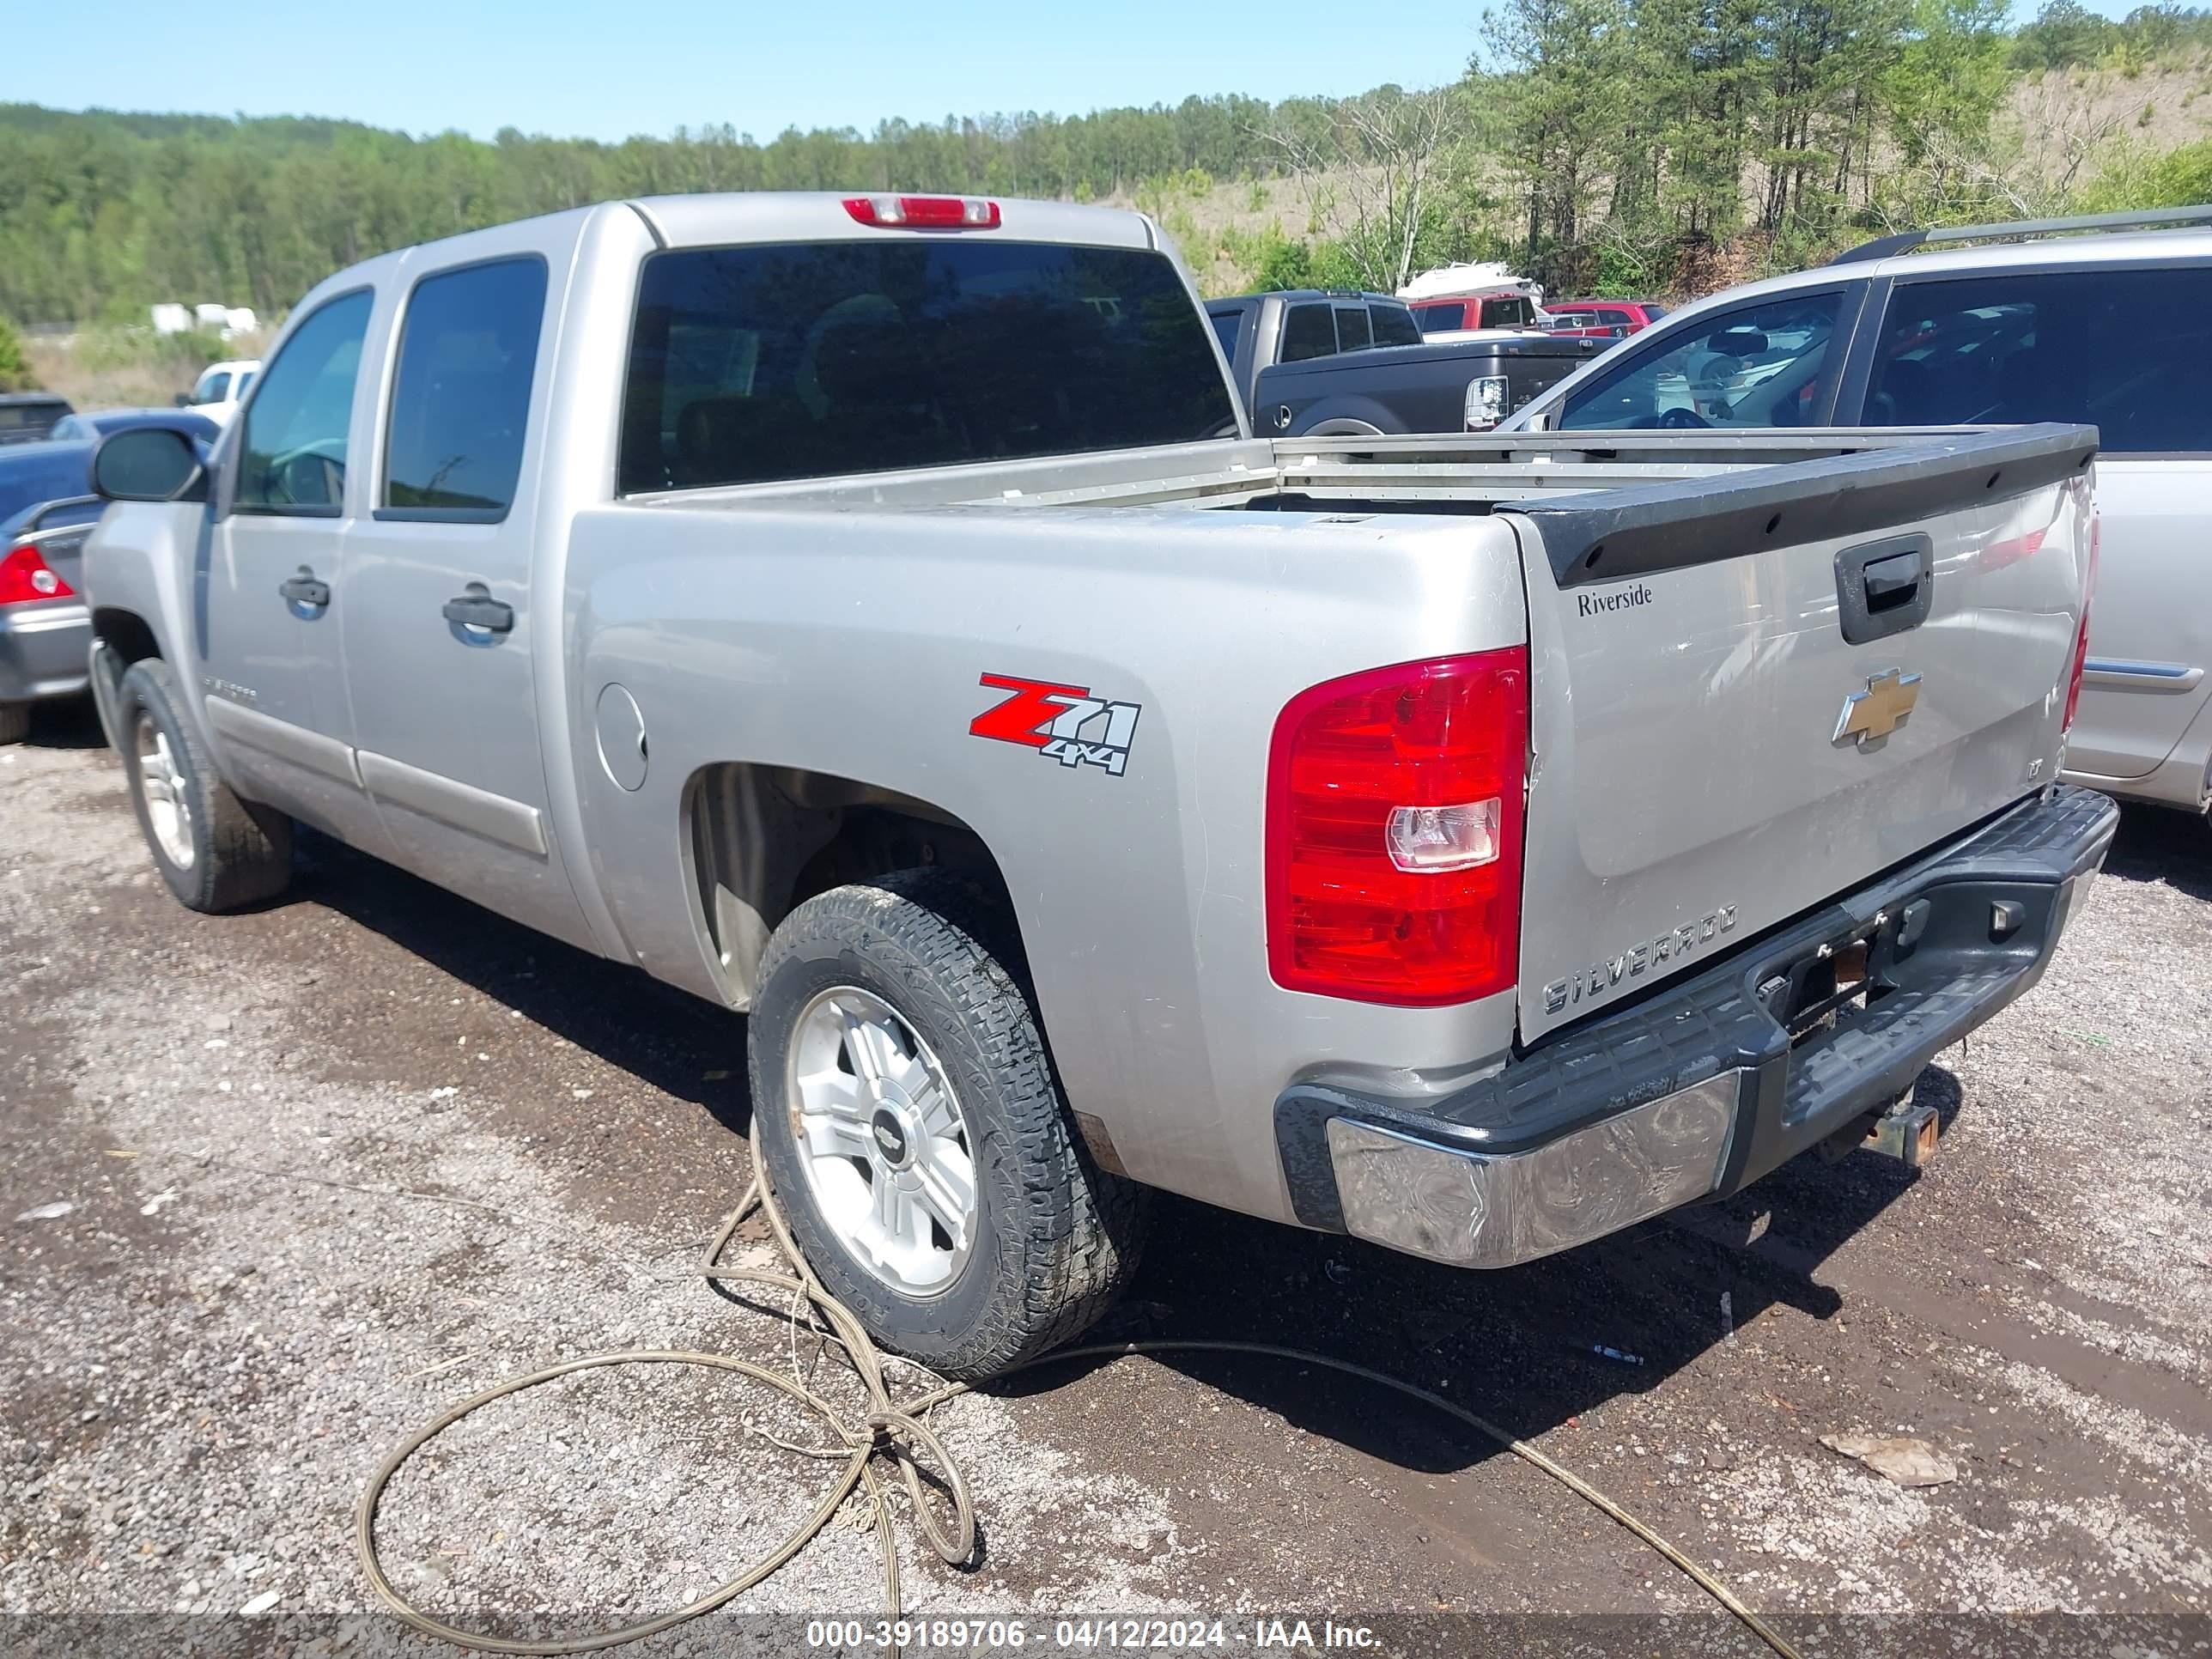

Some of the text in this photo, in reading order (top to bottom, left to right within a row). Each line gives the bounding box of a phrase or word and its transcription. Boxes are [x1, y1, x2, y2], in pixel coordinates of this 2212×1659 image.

[1577, 584, 1652, 617] Riverside
[969, 672, 1142, 750] Z71
[1544, 904, 1737, 1014] SILVERADO
